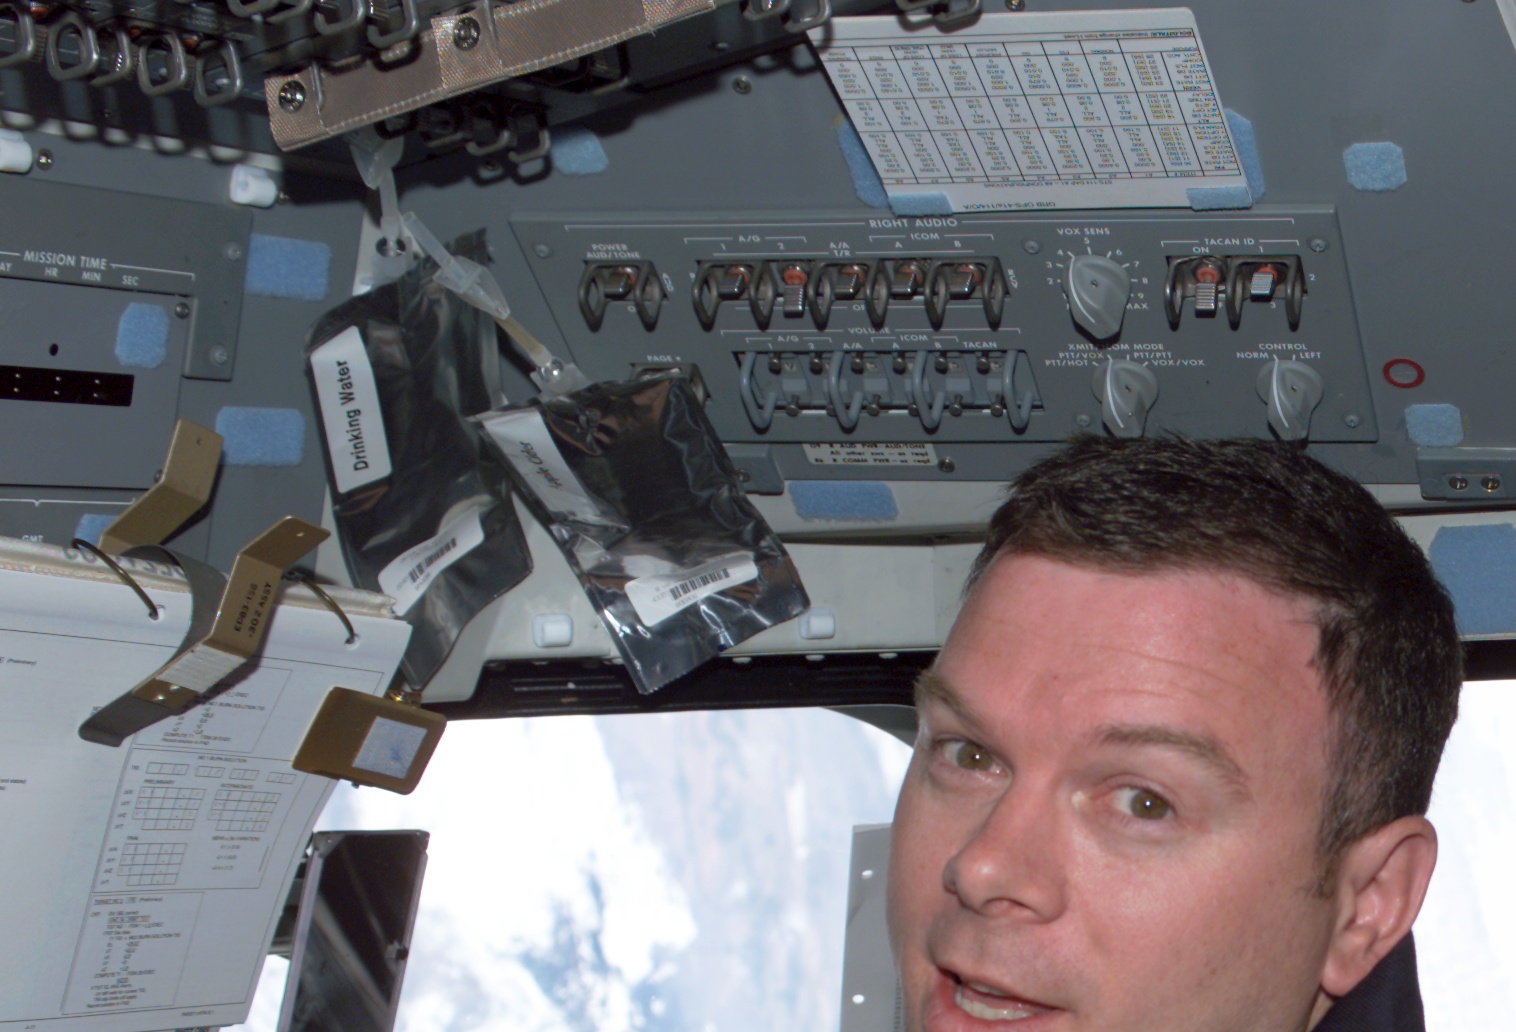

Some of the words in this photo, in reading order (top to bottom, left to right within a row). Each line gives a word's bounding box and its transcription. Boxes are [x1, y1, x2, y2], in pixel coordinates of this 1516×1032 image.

[869, 219, 908, 229] RIGHT
[915, 218, 957, 228] AUDIO
[911, 232, 940, 240] ICOM
[592, 243, 628, 252] POWER
[829, 241, 850, 249] A/A
[954, 240, 961, 248] B
[24, 250, 76, 267] MISSION
[80, 256, 107, 270] TIME
[587, 251, 640, 260] AUD/TONE
[44, 267, 58, 278] HR
[81, 271, 101, 282] MIN
[122, 275, 140, 286] SEC
[337, 360, 355, 406] Water
[346, 408, 369, 472] Drinking
